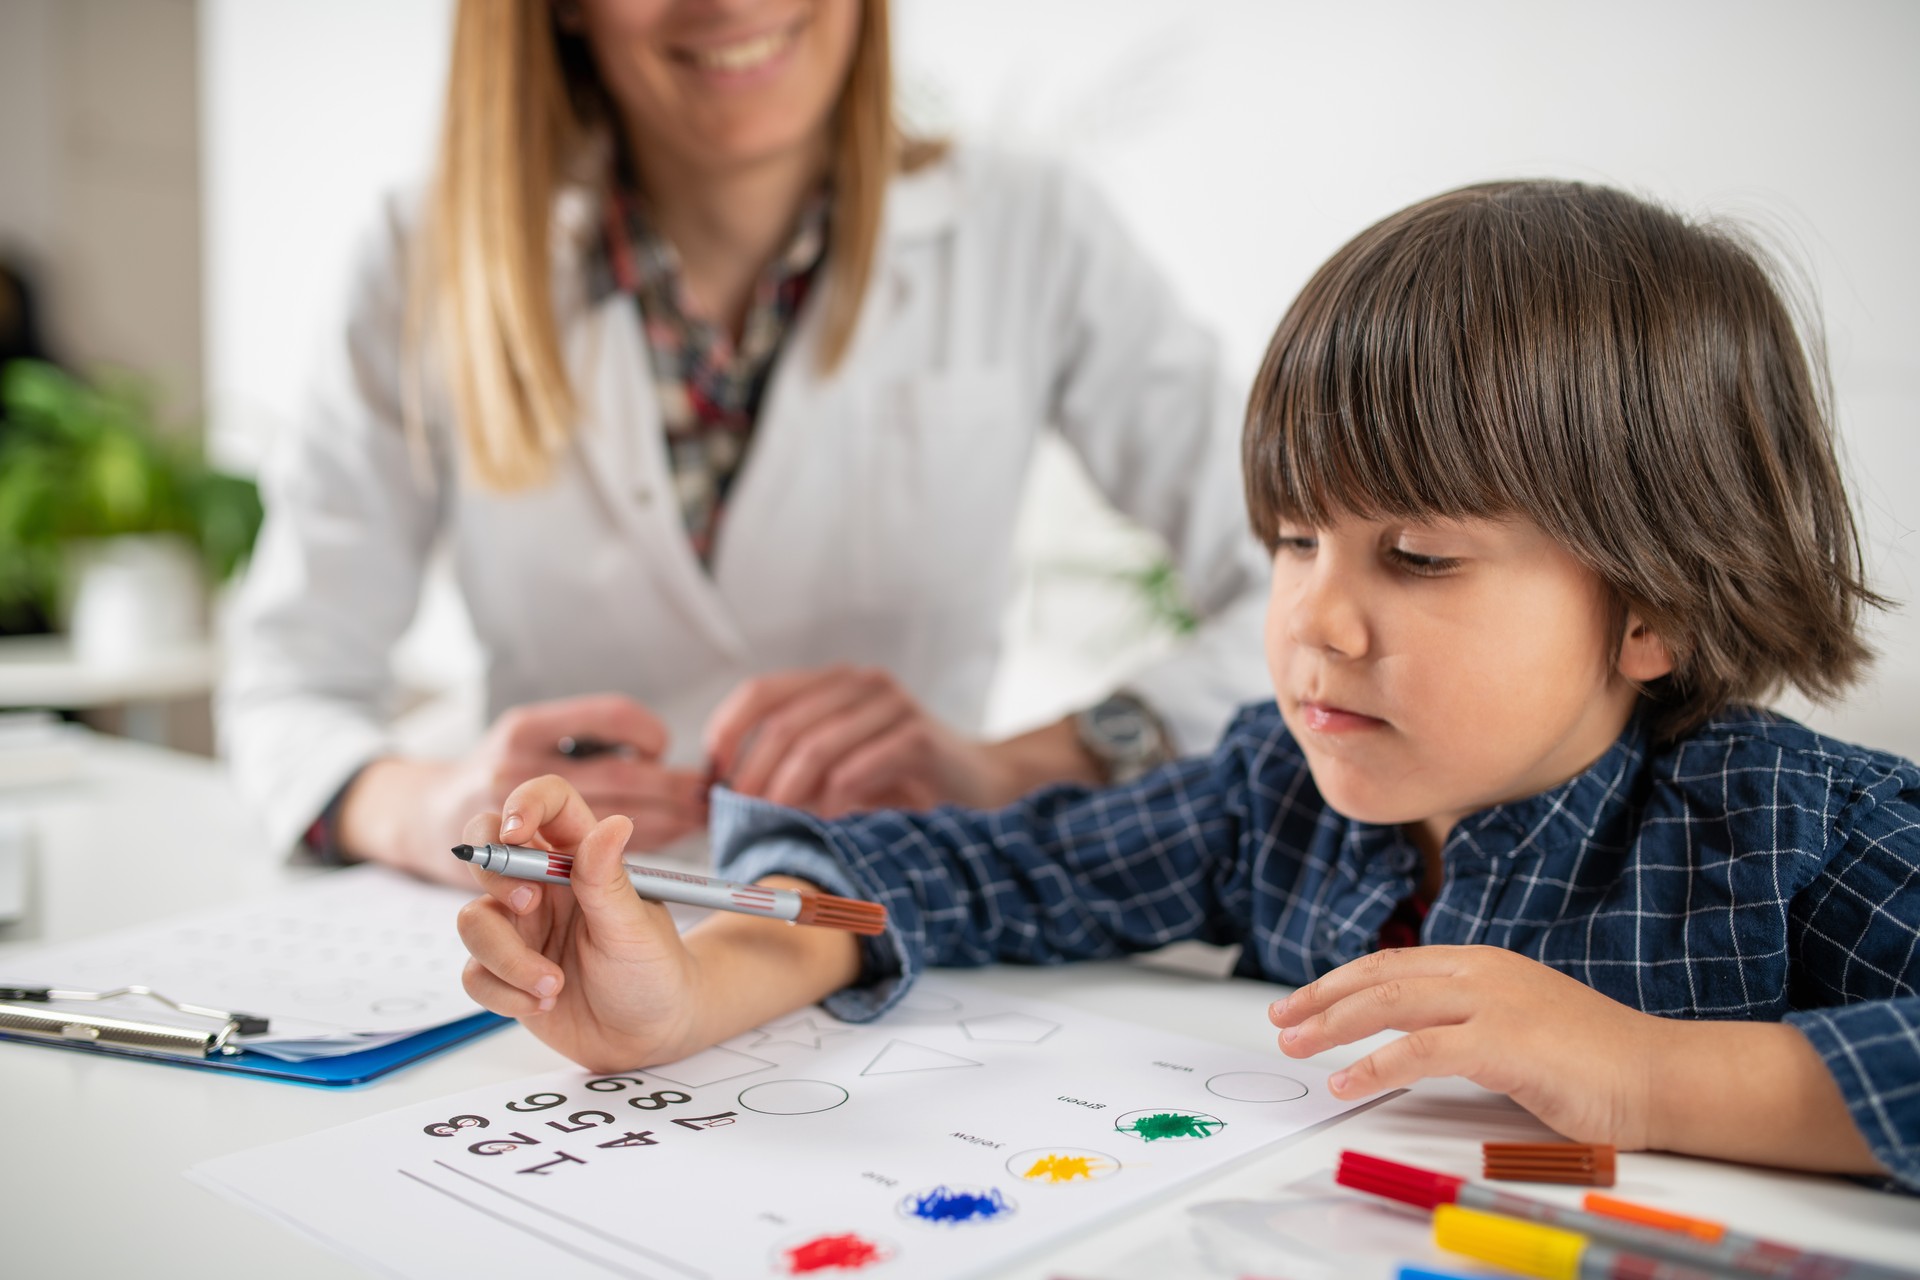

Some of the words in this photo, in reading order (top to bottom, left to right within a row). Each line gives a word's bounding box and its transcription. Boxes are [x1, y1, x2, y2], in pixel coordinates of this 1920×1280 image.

[584, 1077, 644, 1092] 9
[506, 1094, 568, 1112] 6
[628, 1091, 692, 1111] 8
[1056, 1095, 1108, 1110] green
[424, 1115, 490, 1137] 3
[546, 1111, 615, 1133] 5
[671, 1112, 738, 1130] 7
[468, 1132, 540, 1155] 2
[598, 1130, 658, 1149] 4
[949, 1132, 1006, 1149] yellow
[516, 1150, 586, 1173] 1
[861, 1171, 898, 1187] blue
